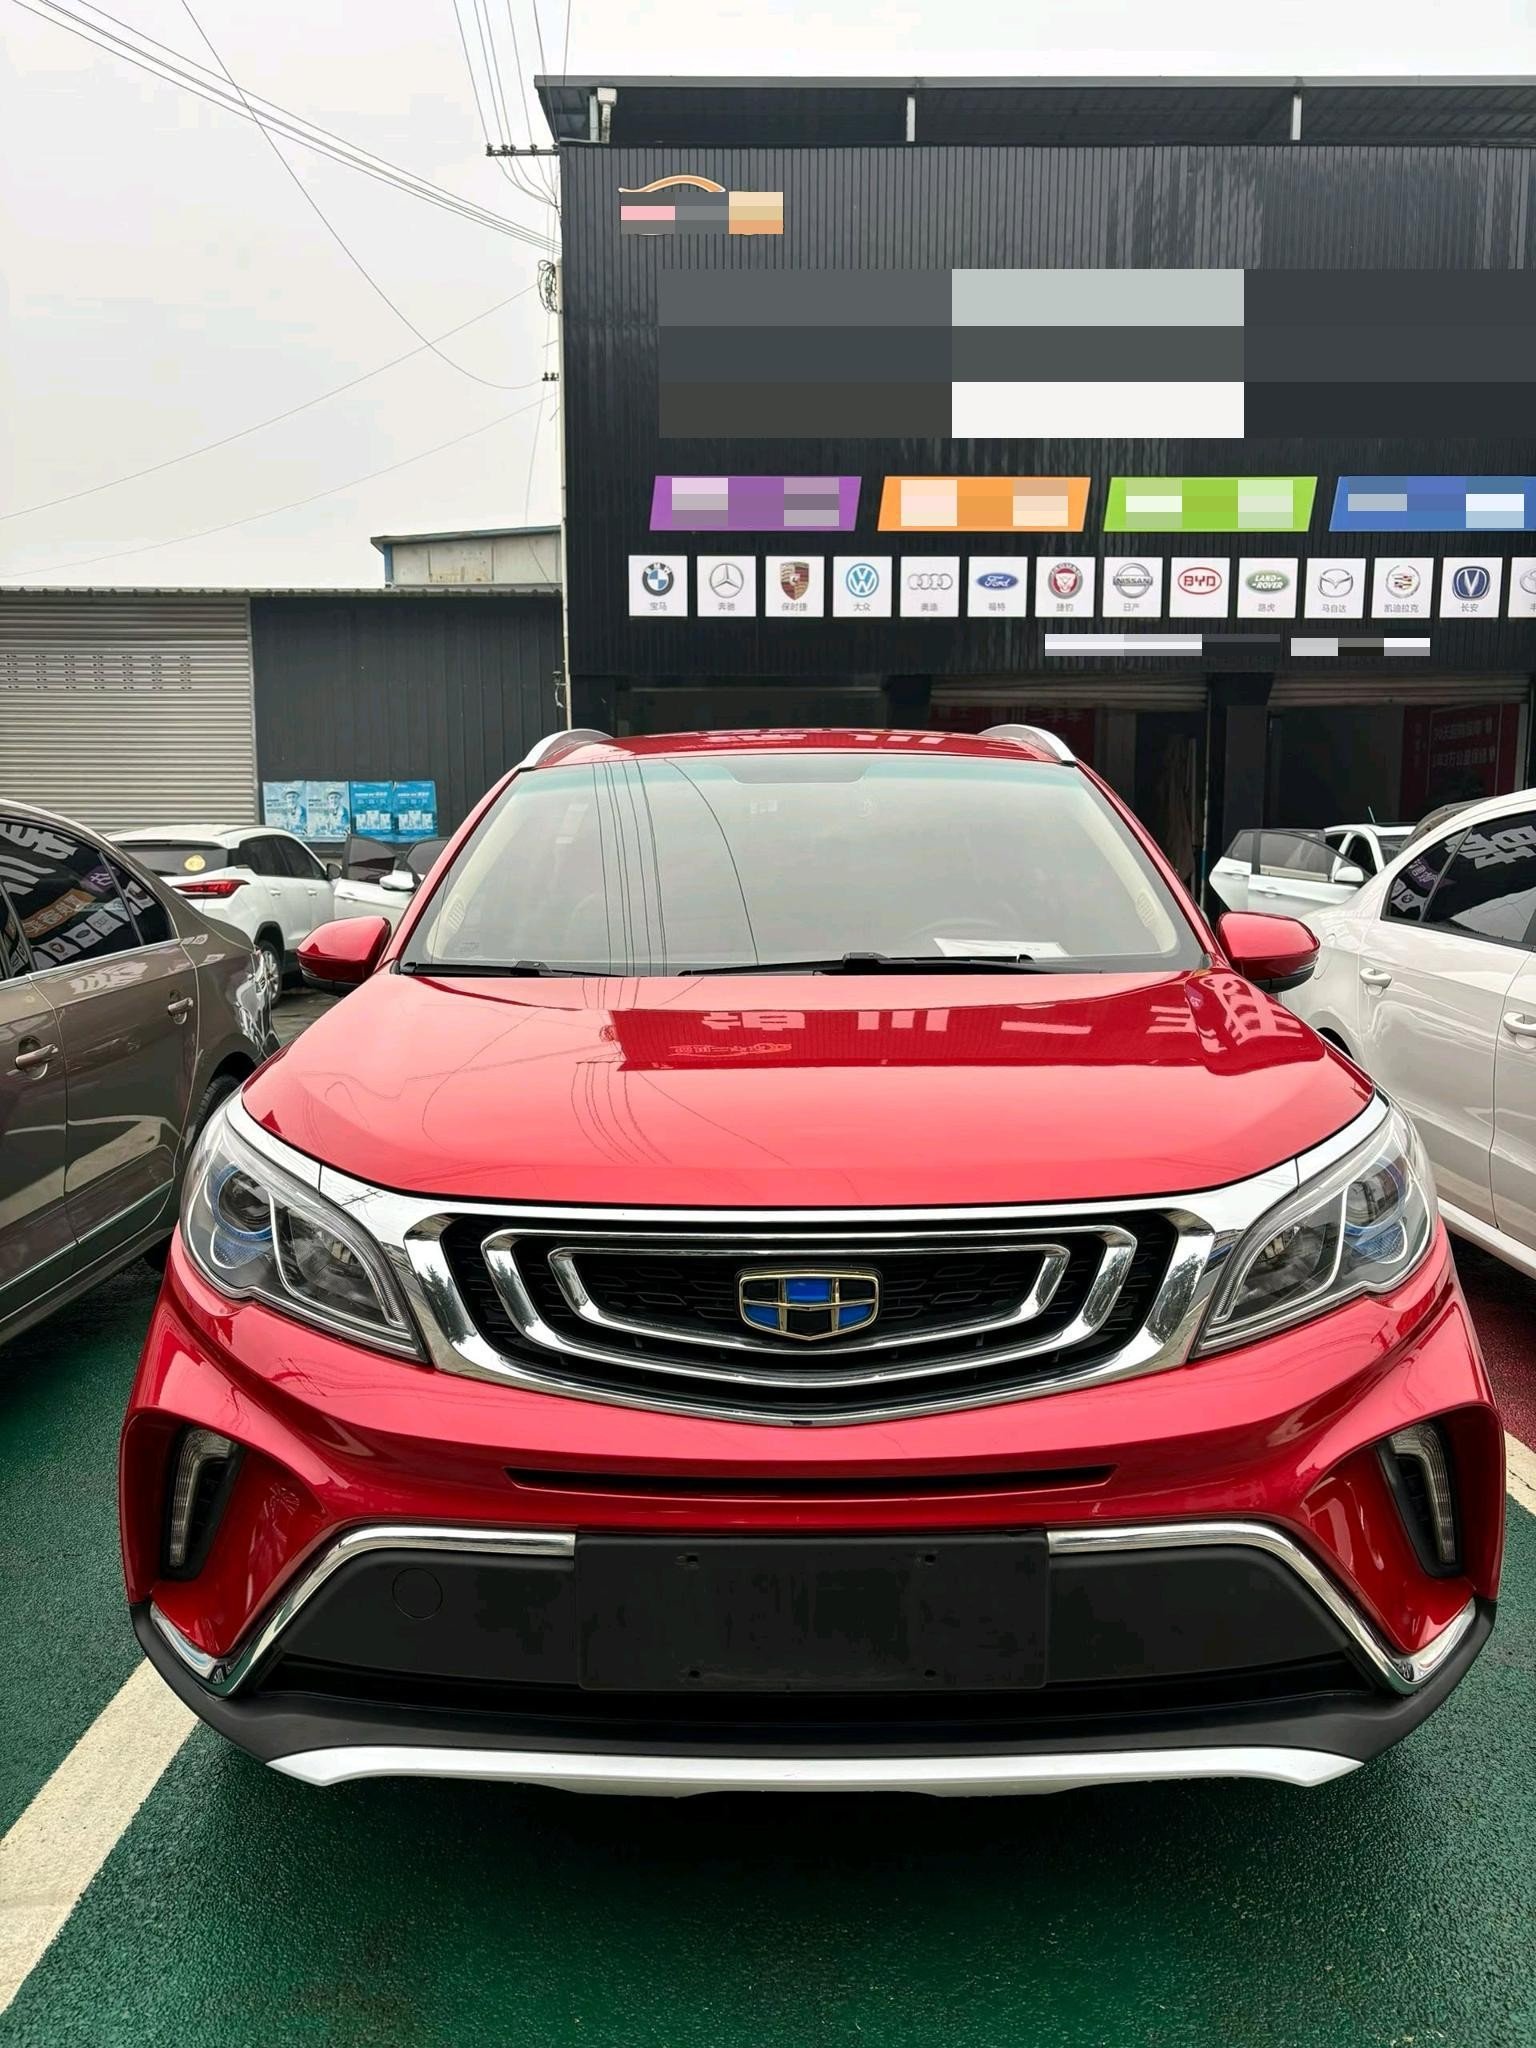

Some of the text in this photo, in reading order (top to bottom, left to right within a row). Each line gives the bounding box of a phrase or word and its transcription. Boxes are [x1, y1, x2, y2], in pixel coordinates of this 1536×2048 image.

[984, 575, 1011, 587] Ford
[1184, 576, 1216, 587] BYD
[650, 602, 667, 611] 宝马
[781, 602, 807, 611] 保时捷
[854, 602, 871, 612] 大众
[1124, 602, 1140, 612] 日产
[1322, 604, 1346, 613] 马自达
[1384, 604, 1419, 613] 凯迪拉克
[1461, 603, 1479, 612] 长安
